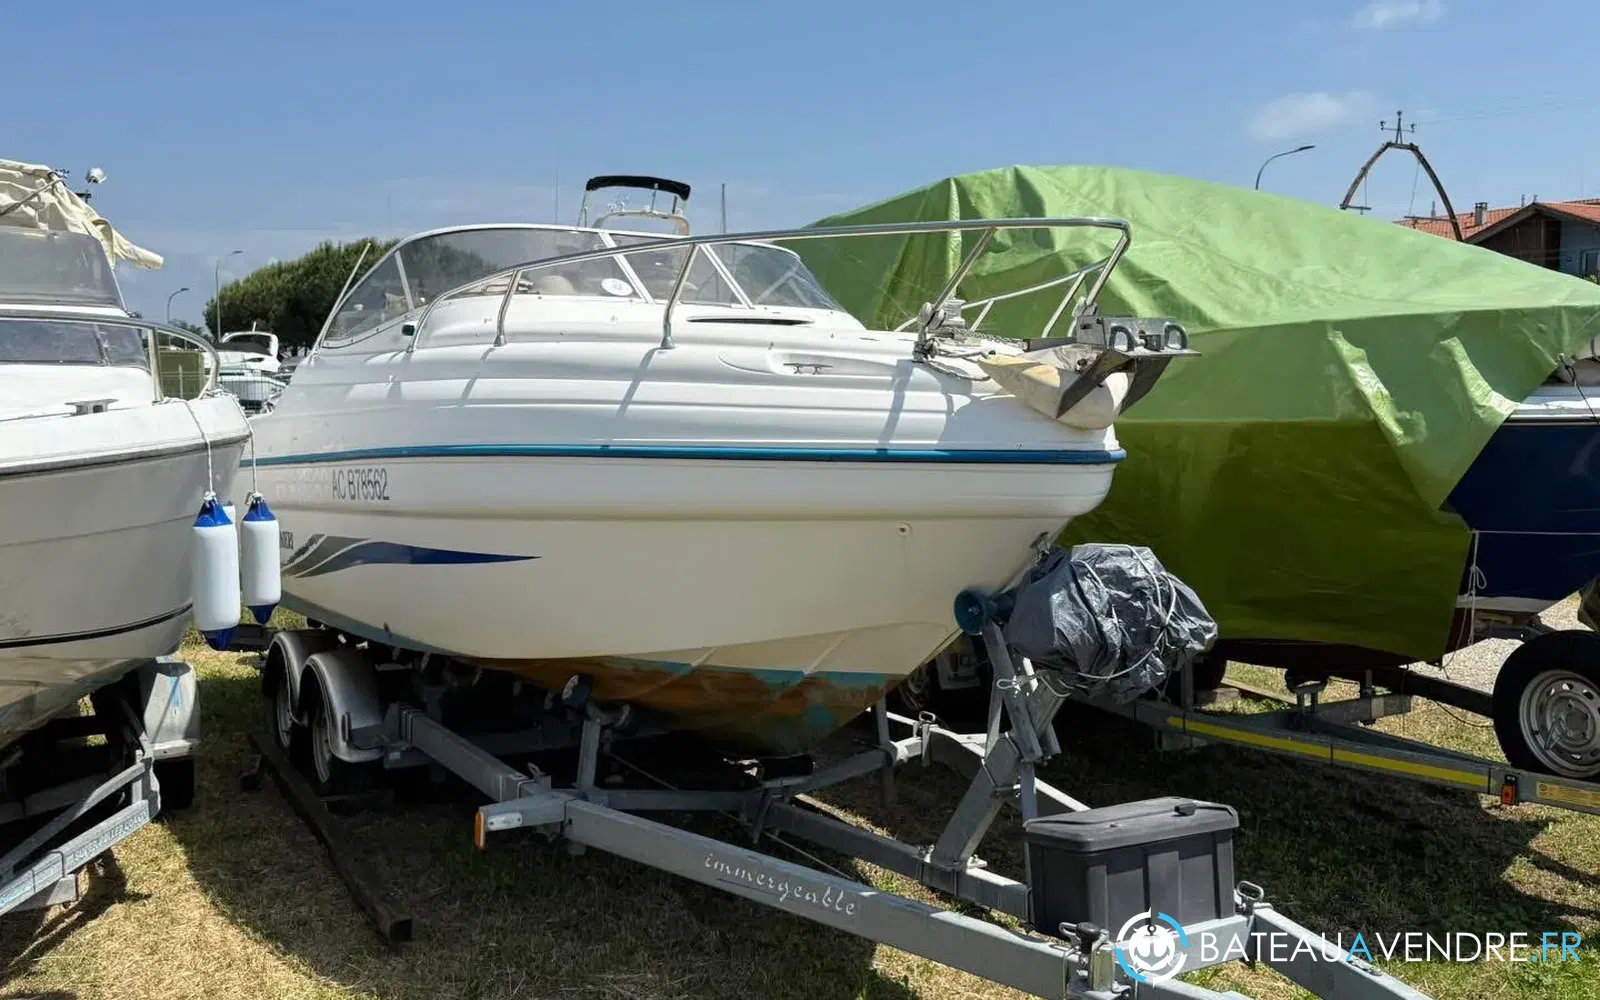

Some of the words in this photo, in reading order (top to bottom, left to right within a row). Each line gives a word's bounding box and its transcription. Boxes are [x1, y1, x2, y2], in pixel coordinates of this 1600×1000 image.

[332, 468, 346, 500] AC
[347, 468, 390, 501] B78562
[704, 853, 855, 915] immergeable
